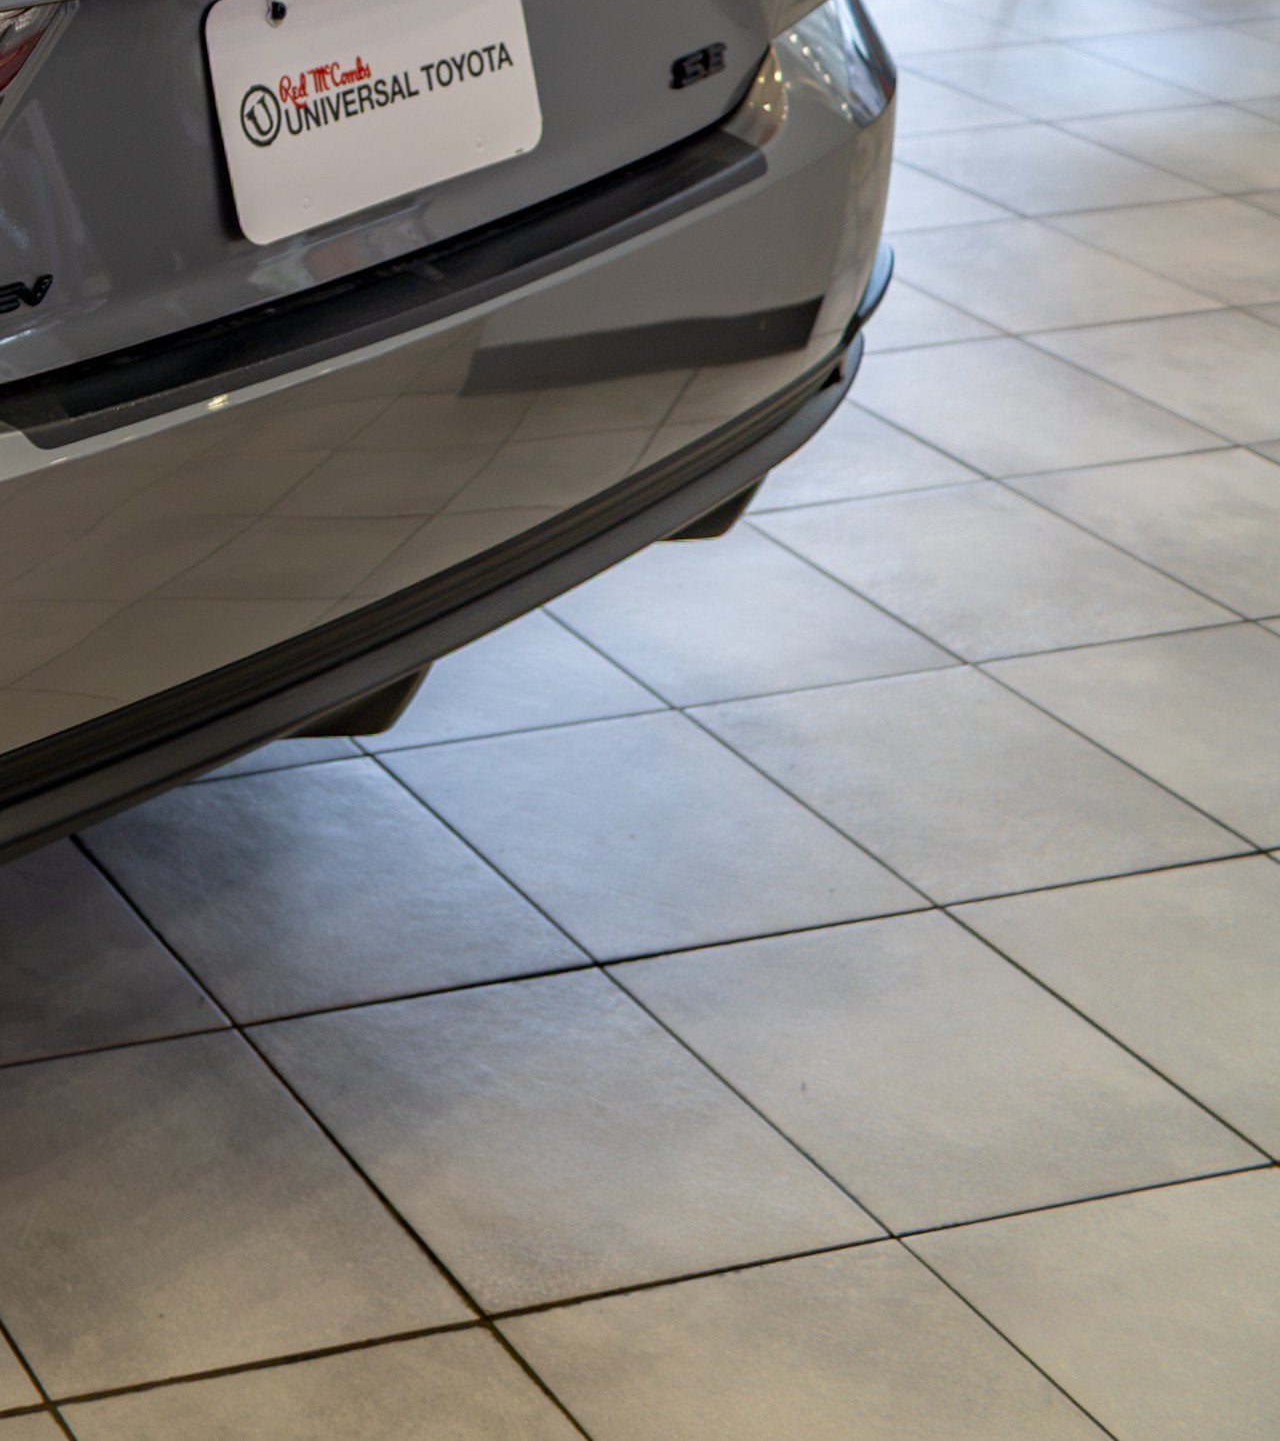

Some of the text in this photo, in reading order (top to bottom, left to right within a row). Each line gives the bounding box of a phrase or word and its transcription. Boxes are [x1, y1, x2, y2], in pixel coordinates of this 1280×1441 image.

[279, 56, 372, 109] Red McCombs
[284, 41, 515, 136] UNIVERSAL TOYOTA
[668, 42, 727, 90] SE
